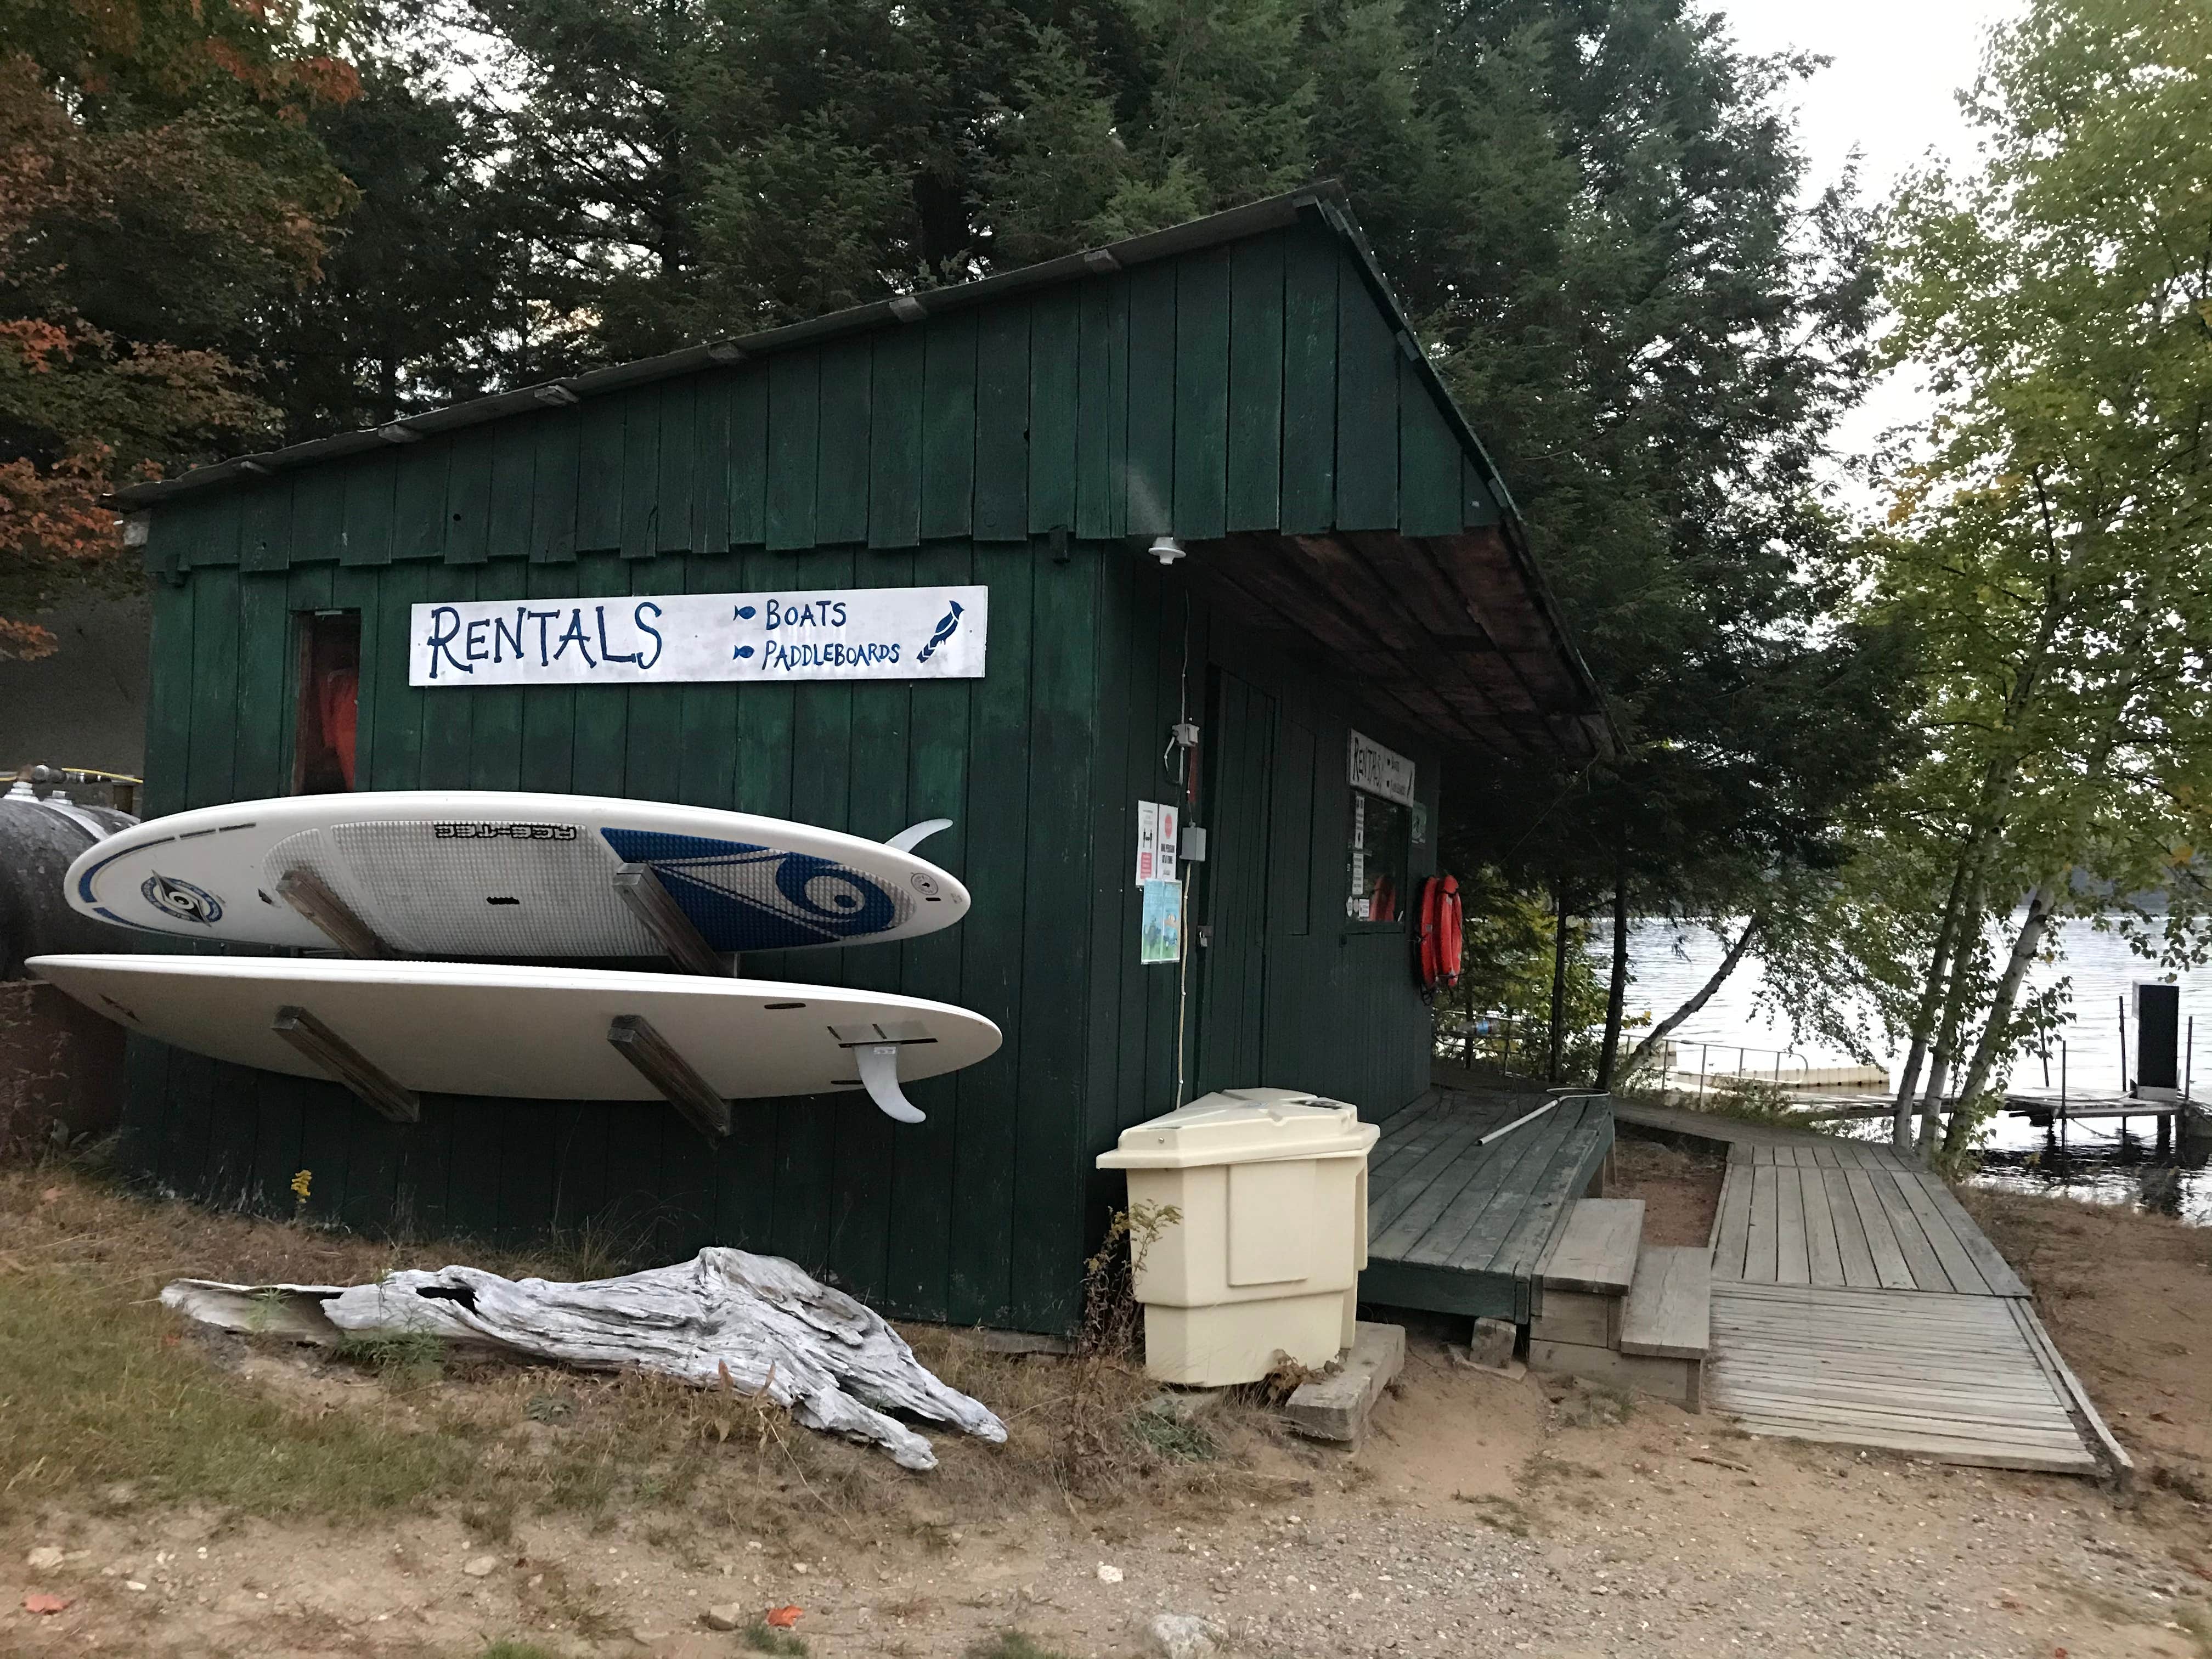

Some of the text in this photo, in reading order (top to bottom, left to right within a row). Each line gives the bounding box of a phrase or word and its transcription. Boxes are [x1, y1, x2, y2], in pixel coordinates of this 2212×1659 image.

[766, 599, 847, 630] BOATS
[427, 602, 662, 679] RENTALS
[762, 640, 900, 671] PADDLEBOARDS
